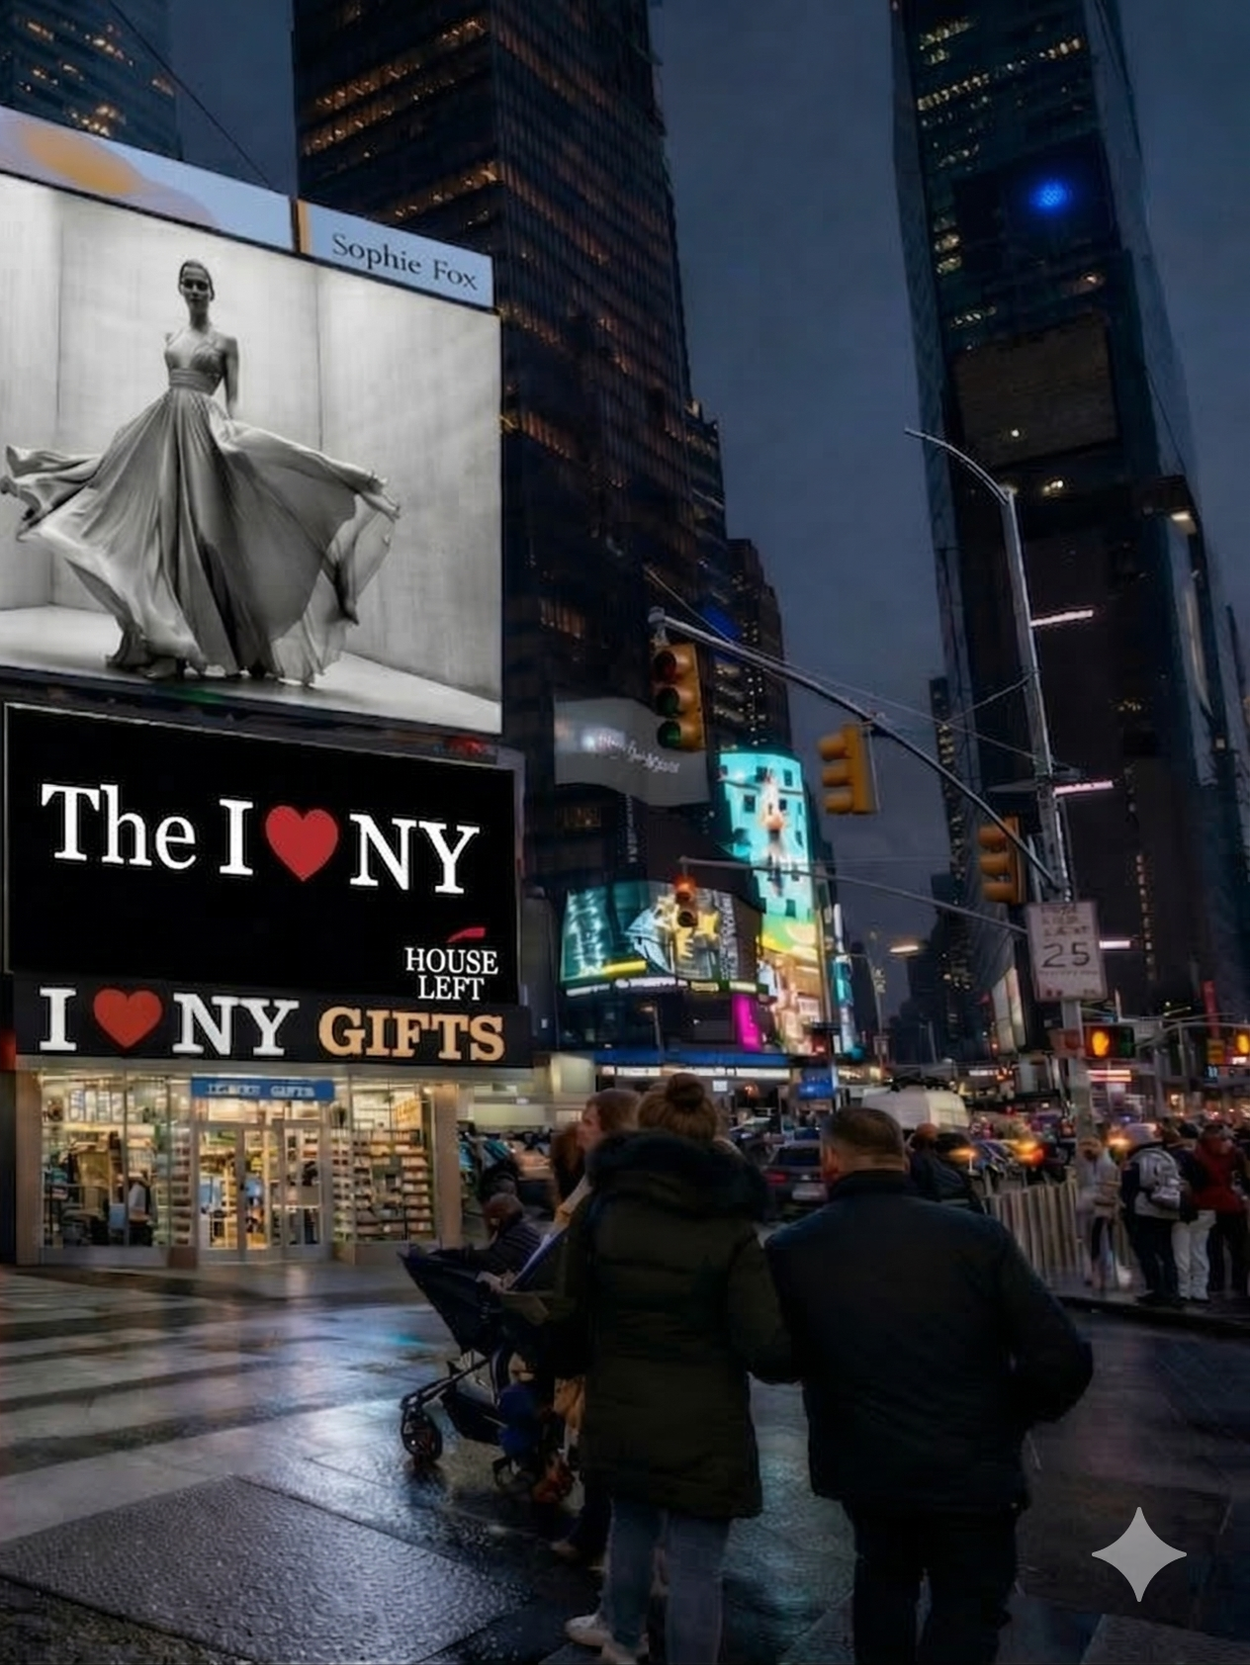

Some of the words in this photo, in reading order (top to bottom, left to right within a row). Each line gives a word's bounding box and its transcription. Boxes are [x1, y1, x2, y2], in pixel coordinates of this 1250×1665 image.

[332, 233, 423, 274] Sophie
[433, 259, 478, 291] Fox
[41, 783, 197, 870] The
[219, 798, 254, 876] I
[349, 813, 481, 895] NY
[404, 947, 499, 975] HOUSE
[1041, 941, 1091, 968] 25
[417, 974, 485, 1001] LEFT
[39, 987, 77, 1051] I
[172, 992, 300, 1056] NY
[318, 1006, 506, 1061] GIFTS
